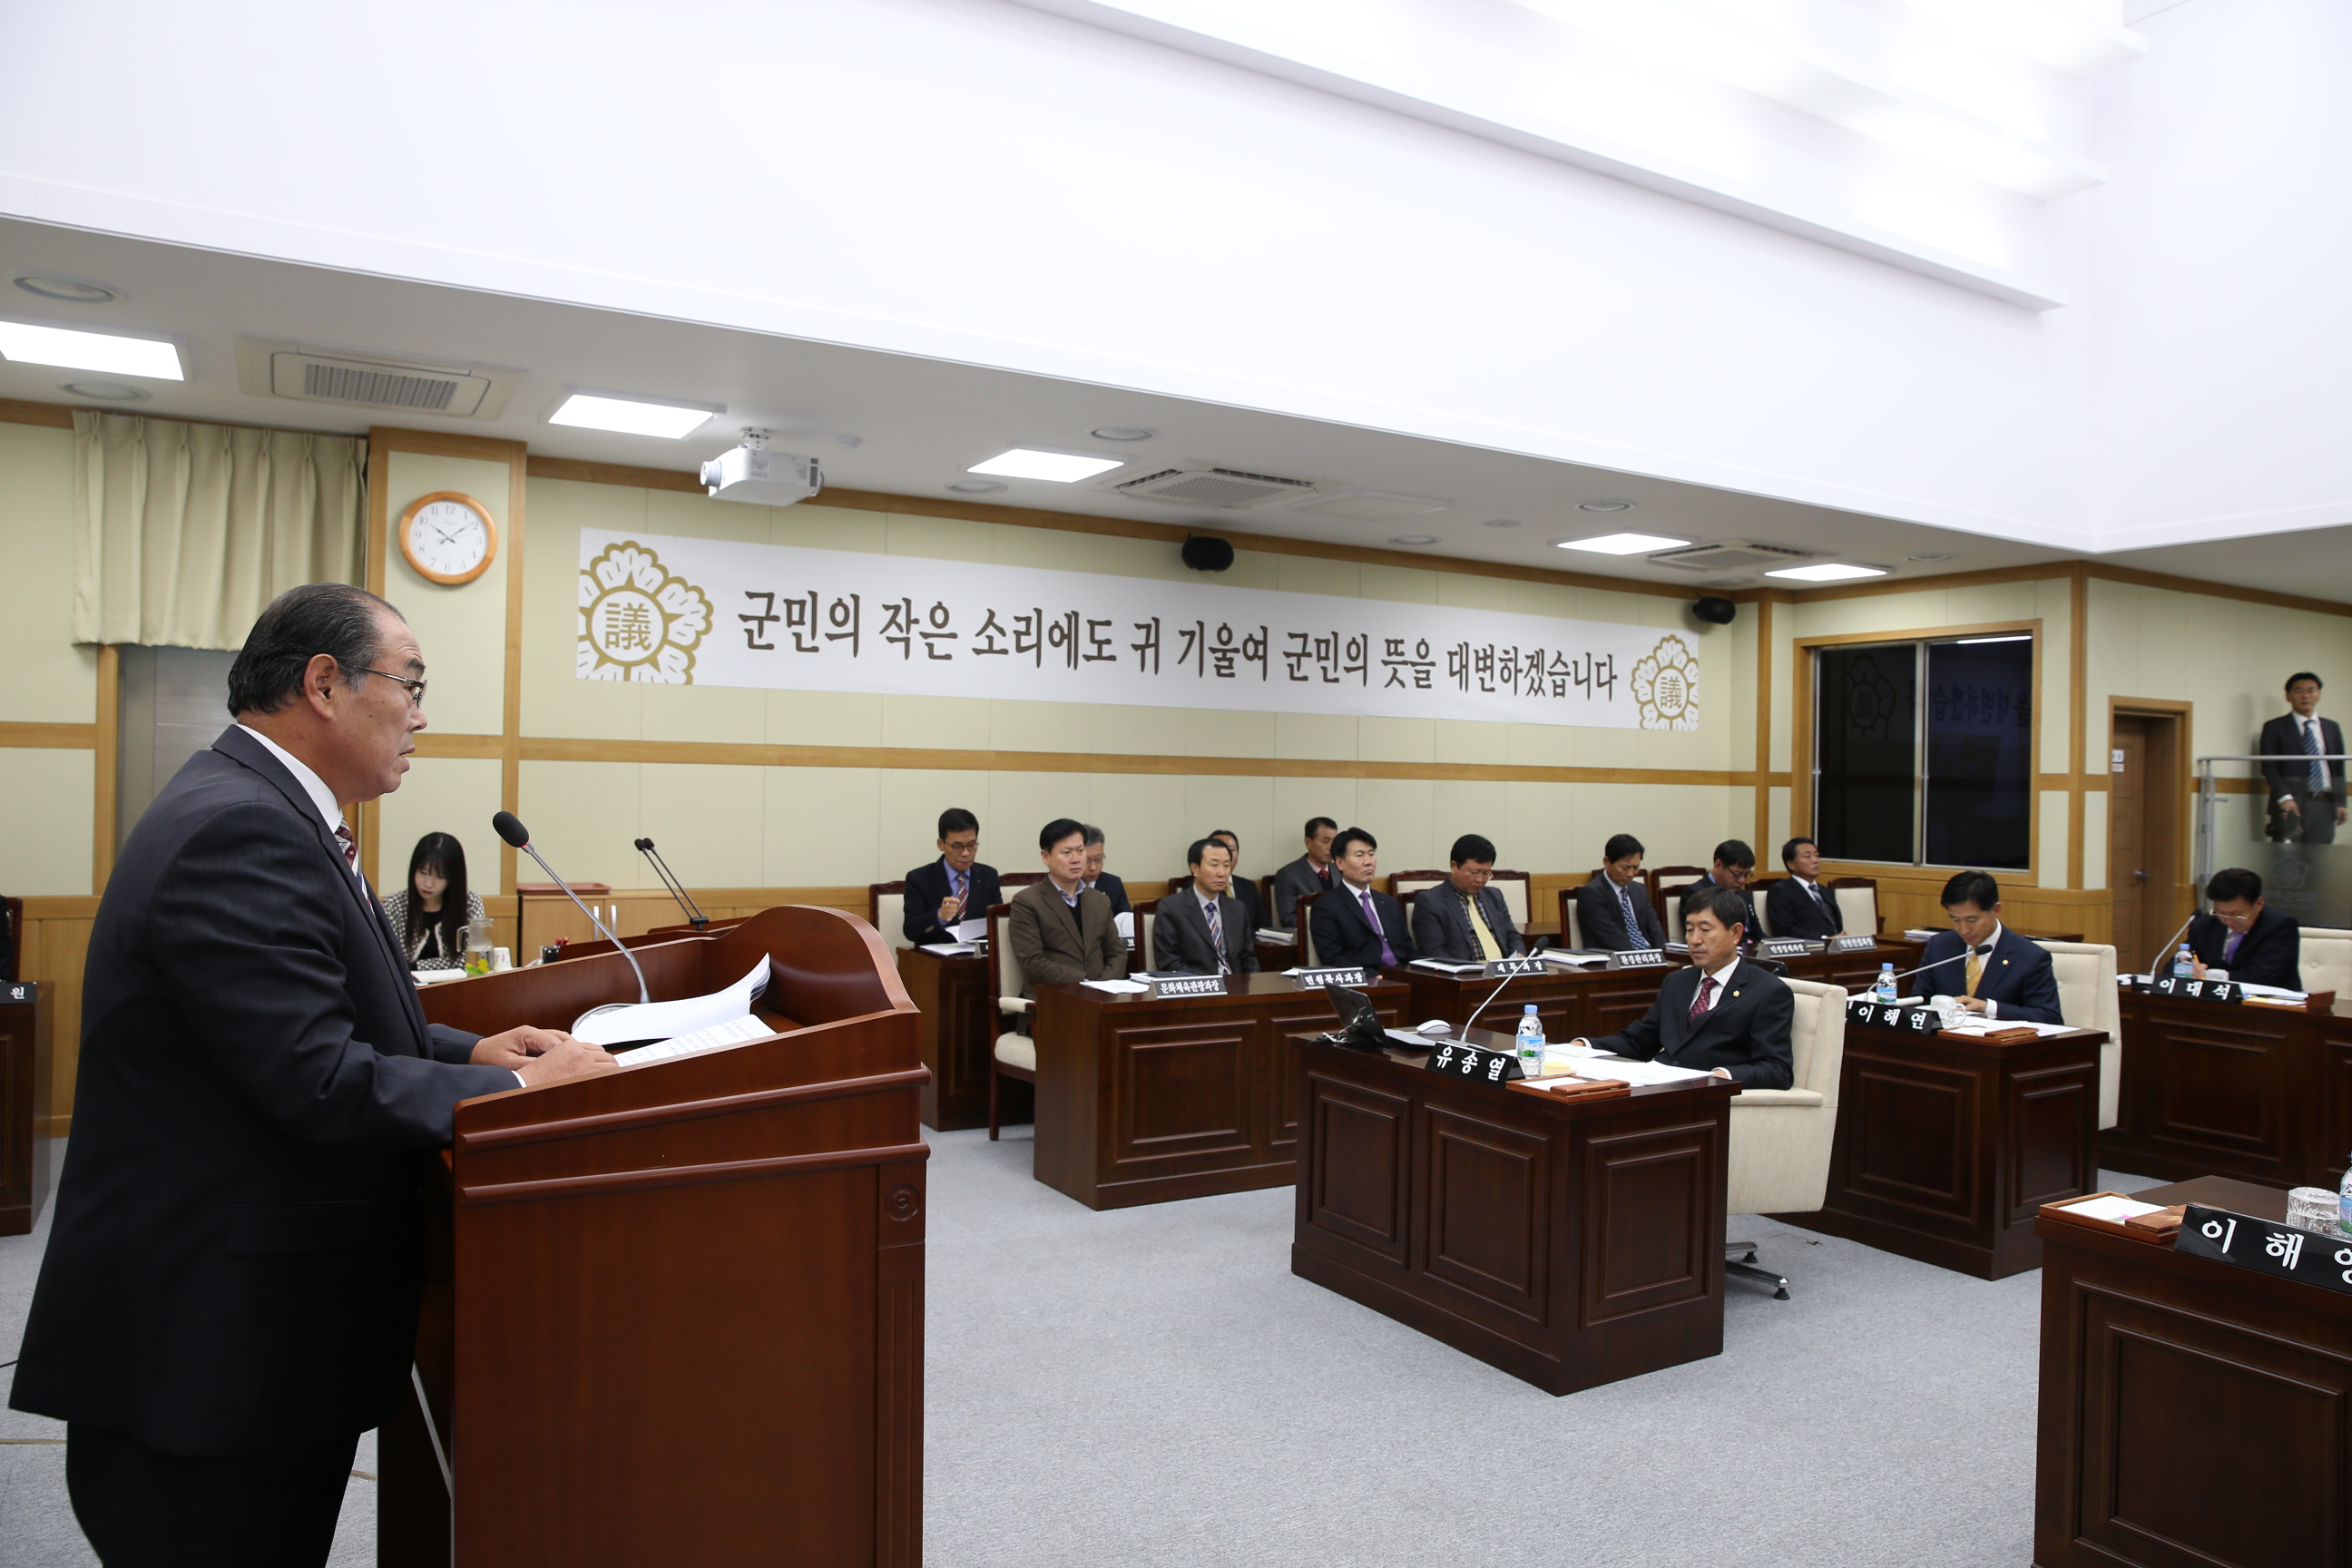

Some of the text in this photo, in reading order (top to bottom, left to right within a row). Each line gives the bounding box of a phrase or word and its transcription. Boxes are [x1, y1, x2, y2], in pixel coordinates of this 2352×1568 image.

[419, 516, 428, 525] 10
[446, 505, 456, 514] 12
[605, 603, 652, 651] 議
[738, 590, 1618, 701] 군민의 작은 소리에도 귀 기울여 군민의 뜻을 대변하겠습니다
[1661, 676, 1682, 709] 議
[1161, 980, 1219, 995] 문화체육관광과장
